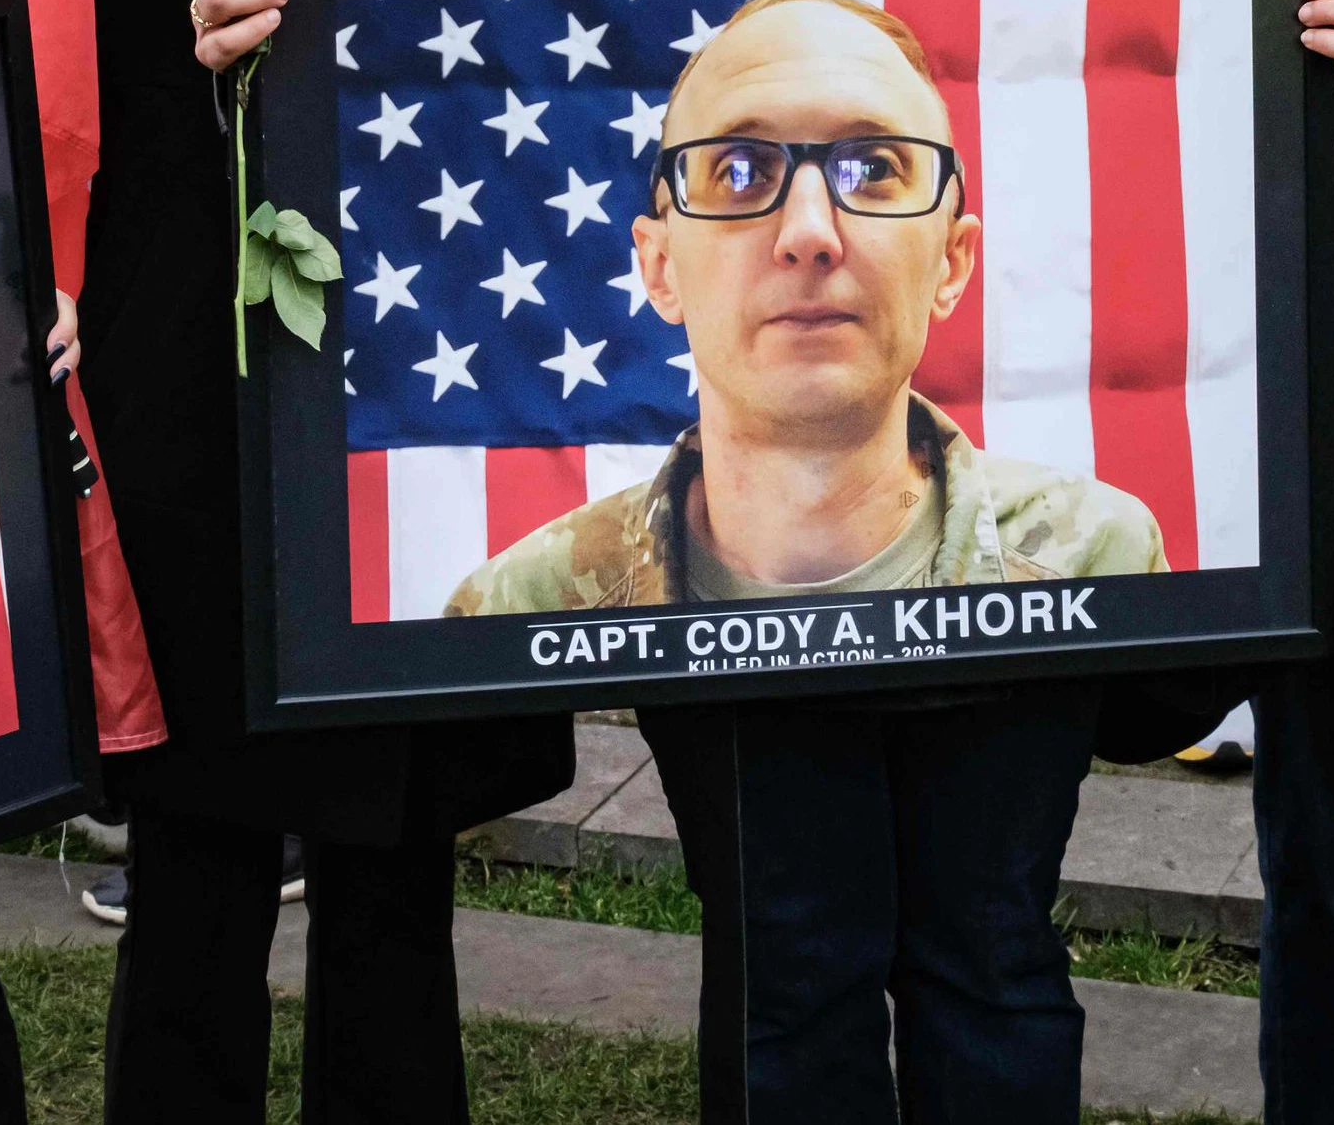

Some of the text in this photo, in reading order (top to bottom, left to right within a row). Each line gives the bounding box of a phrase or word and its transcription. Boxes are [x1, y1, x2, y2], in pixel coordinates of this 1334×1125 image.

[530, 587, 1097, 666] CAPT. CODY A. KHORK
[771, 654, 790, 668] IN
[799, 649, 875, 665] ACTION
[904, 644, 947, 658] 2026
